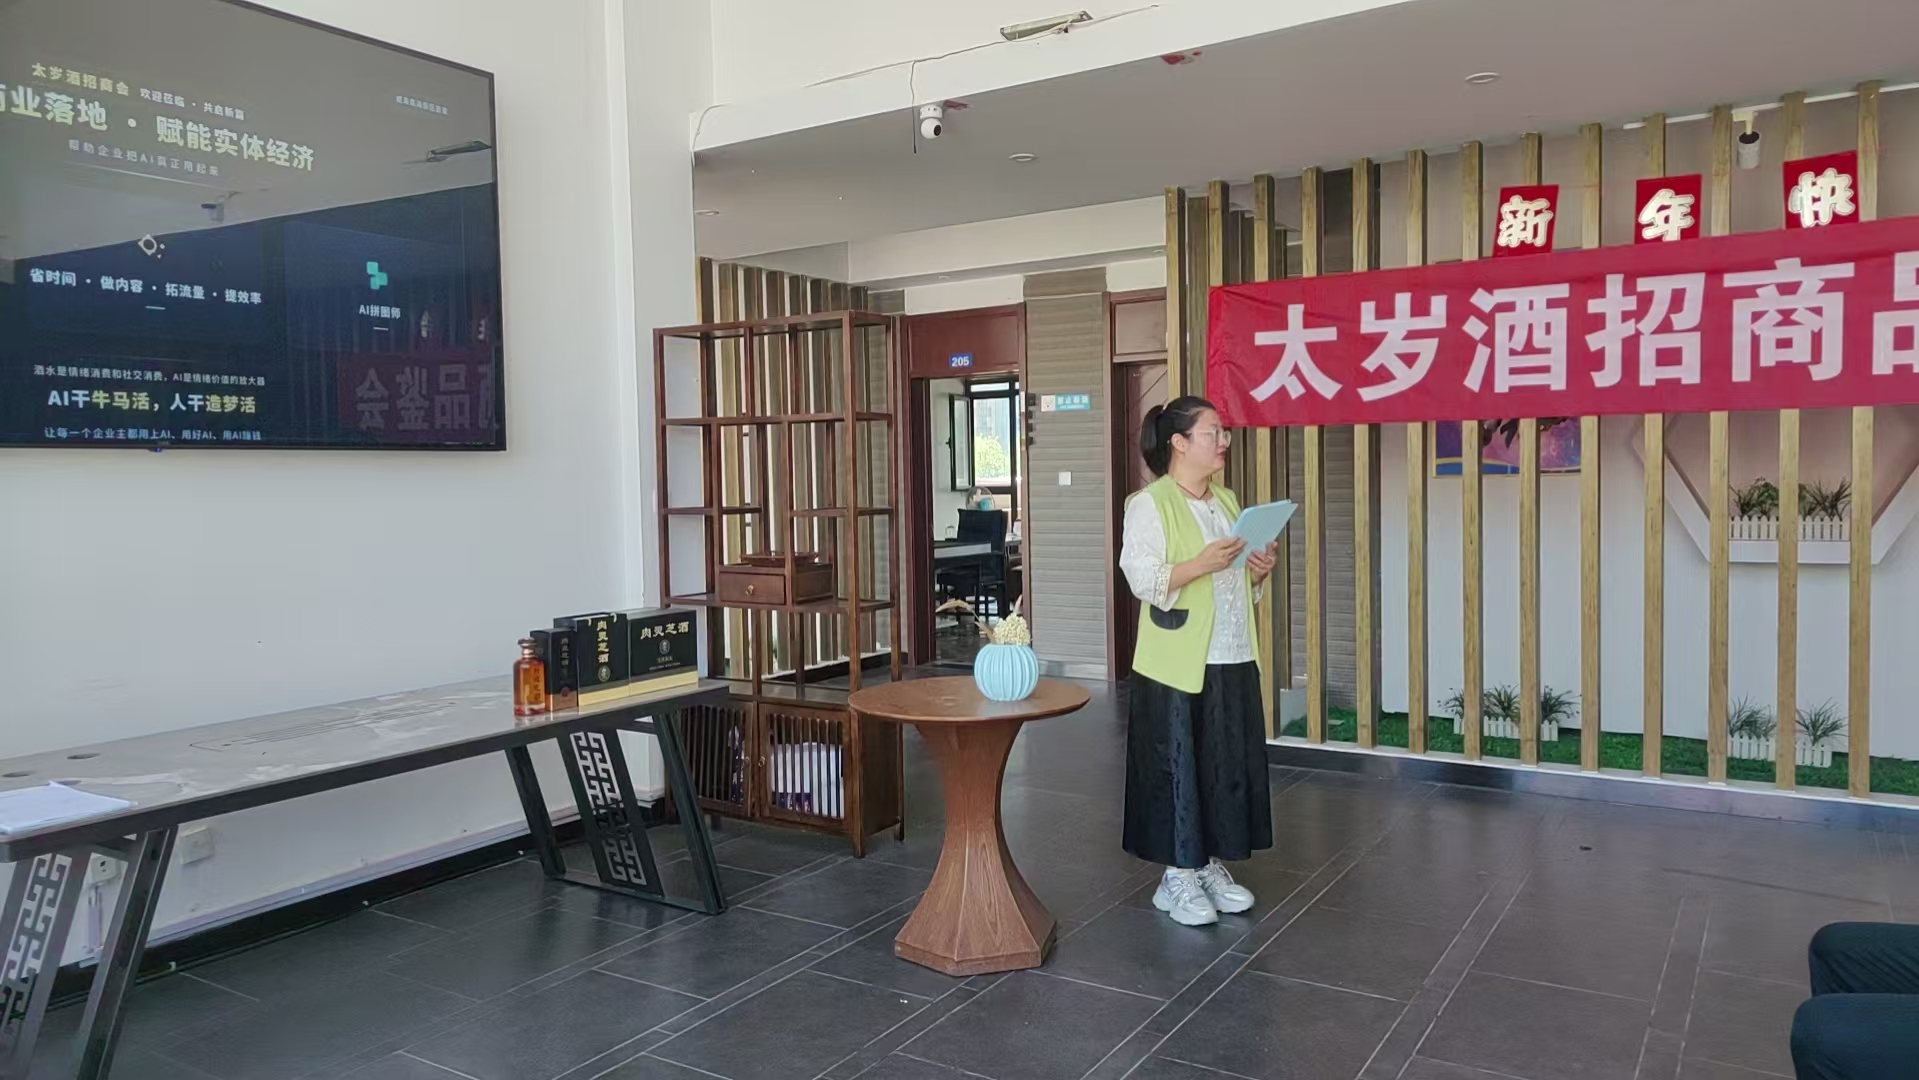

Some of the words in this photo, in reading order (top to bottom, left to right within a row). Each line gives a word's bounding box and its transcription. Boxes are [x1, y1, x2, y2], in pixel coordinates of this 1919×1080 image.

[32, 62, 129, 96] 太岁酒招商会
[140, 88, 184, 108] 欢迎莅临
[0, 84, 107, 131] 业落地
[156, 115, 315, 171] 赋能实体经济
[359, 304, 401, 319] AI拼图师
[951, 356, 970, 367] 205
[48, 390, 256, 413] AI干牛马活，人干造梦活
[640, 621, 689, 640] 肉灵芝酒
